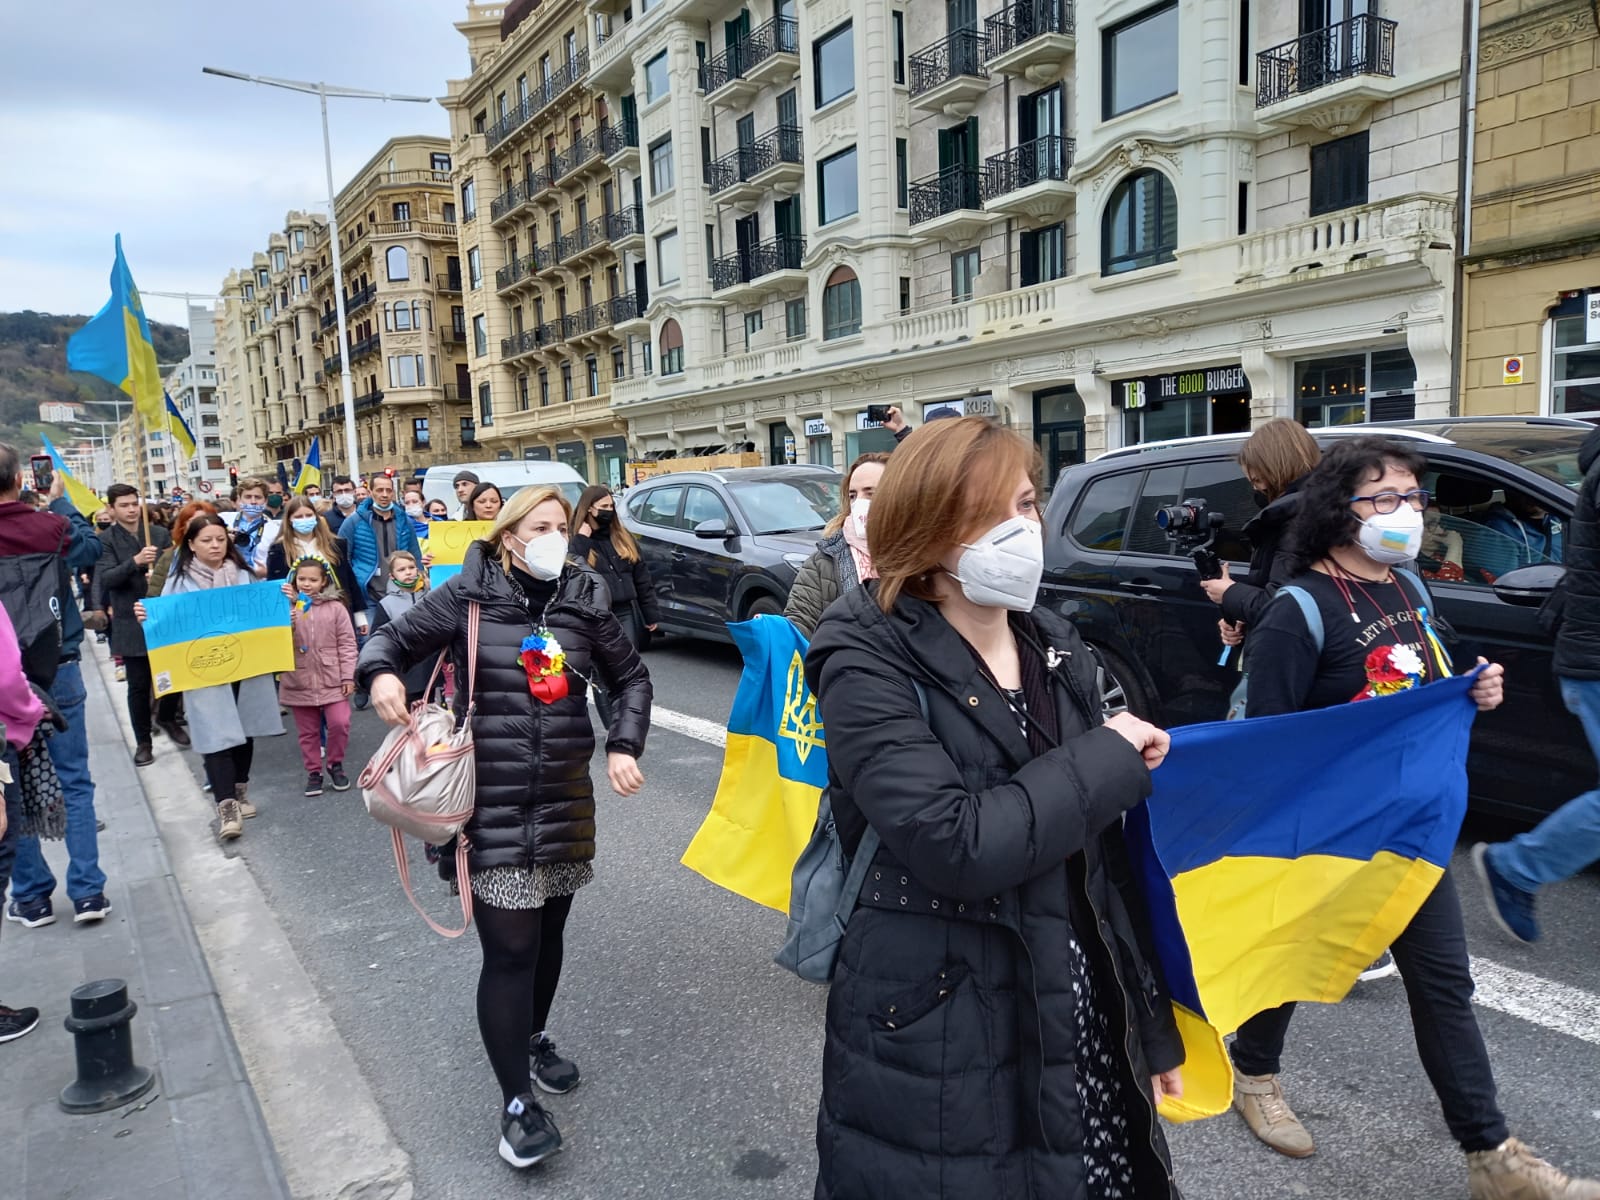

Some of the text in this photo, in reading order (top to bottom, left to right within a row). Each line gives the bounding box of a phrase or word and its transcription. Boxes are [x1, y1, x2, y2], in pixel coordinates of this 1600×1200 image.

[1122, 380, 1146, 409] TGB
[1160, 368, 1245, 397] THE GOOD BURGER
[208, 587, 287, 626] GUERRA
[1355, 622, 1381, 647] LET
